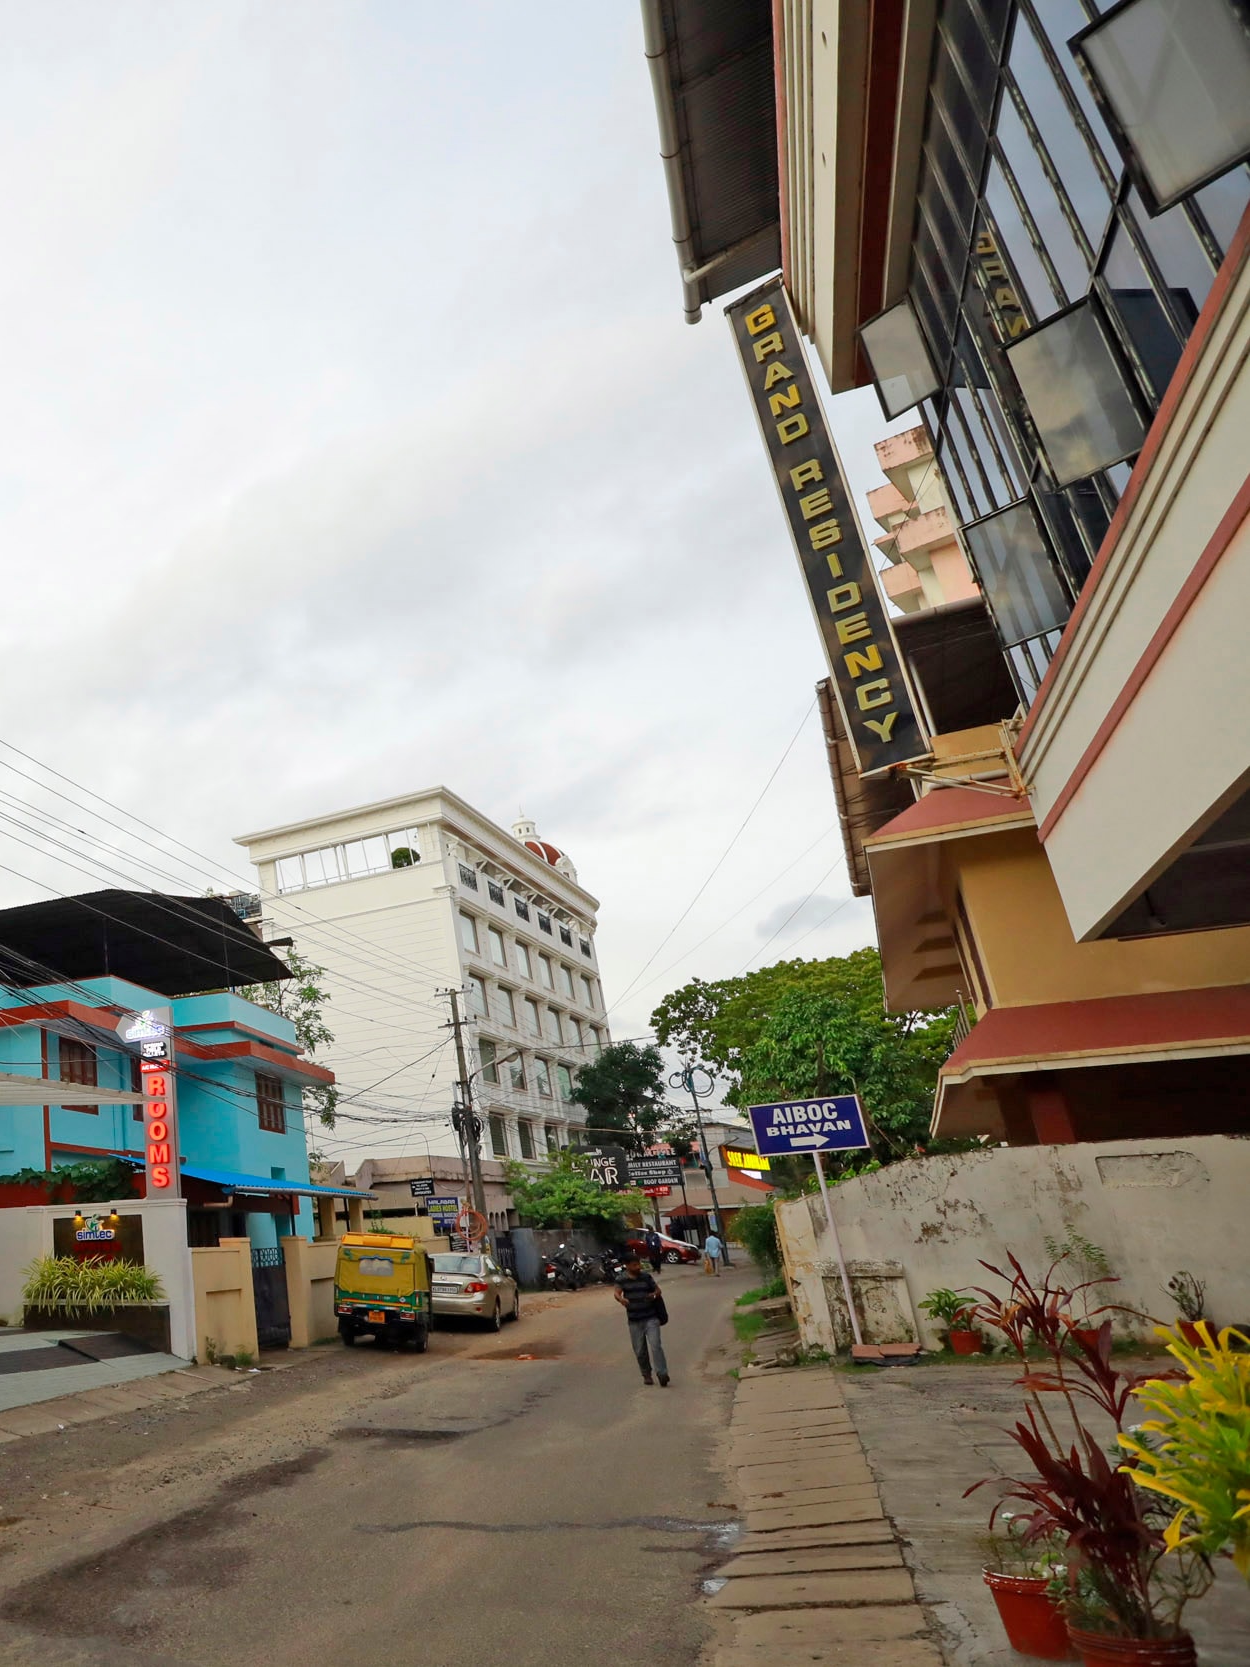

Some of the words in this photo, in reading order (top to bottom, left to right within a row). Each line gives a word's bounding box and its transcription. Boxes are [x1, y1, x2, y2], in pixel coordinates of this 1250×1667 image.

[745, 303, 810, 446] GRAND
[790, 458, 900, 743] RESIDENCY
[772, 1102, 838, 1125] AIBOC
[147, 1075, 170, 1188] ROOMS
[765, 1119, 852, 1137] BHAVAN
[77, 1225, 112, 1240] simtec
